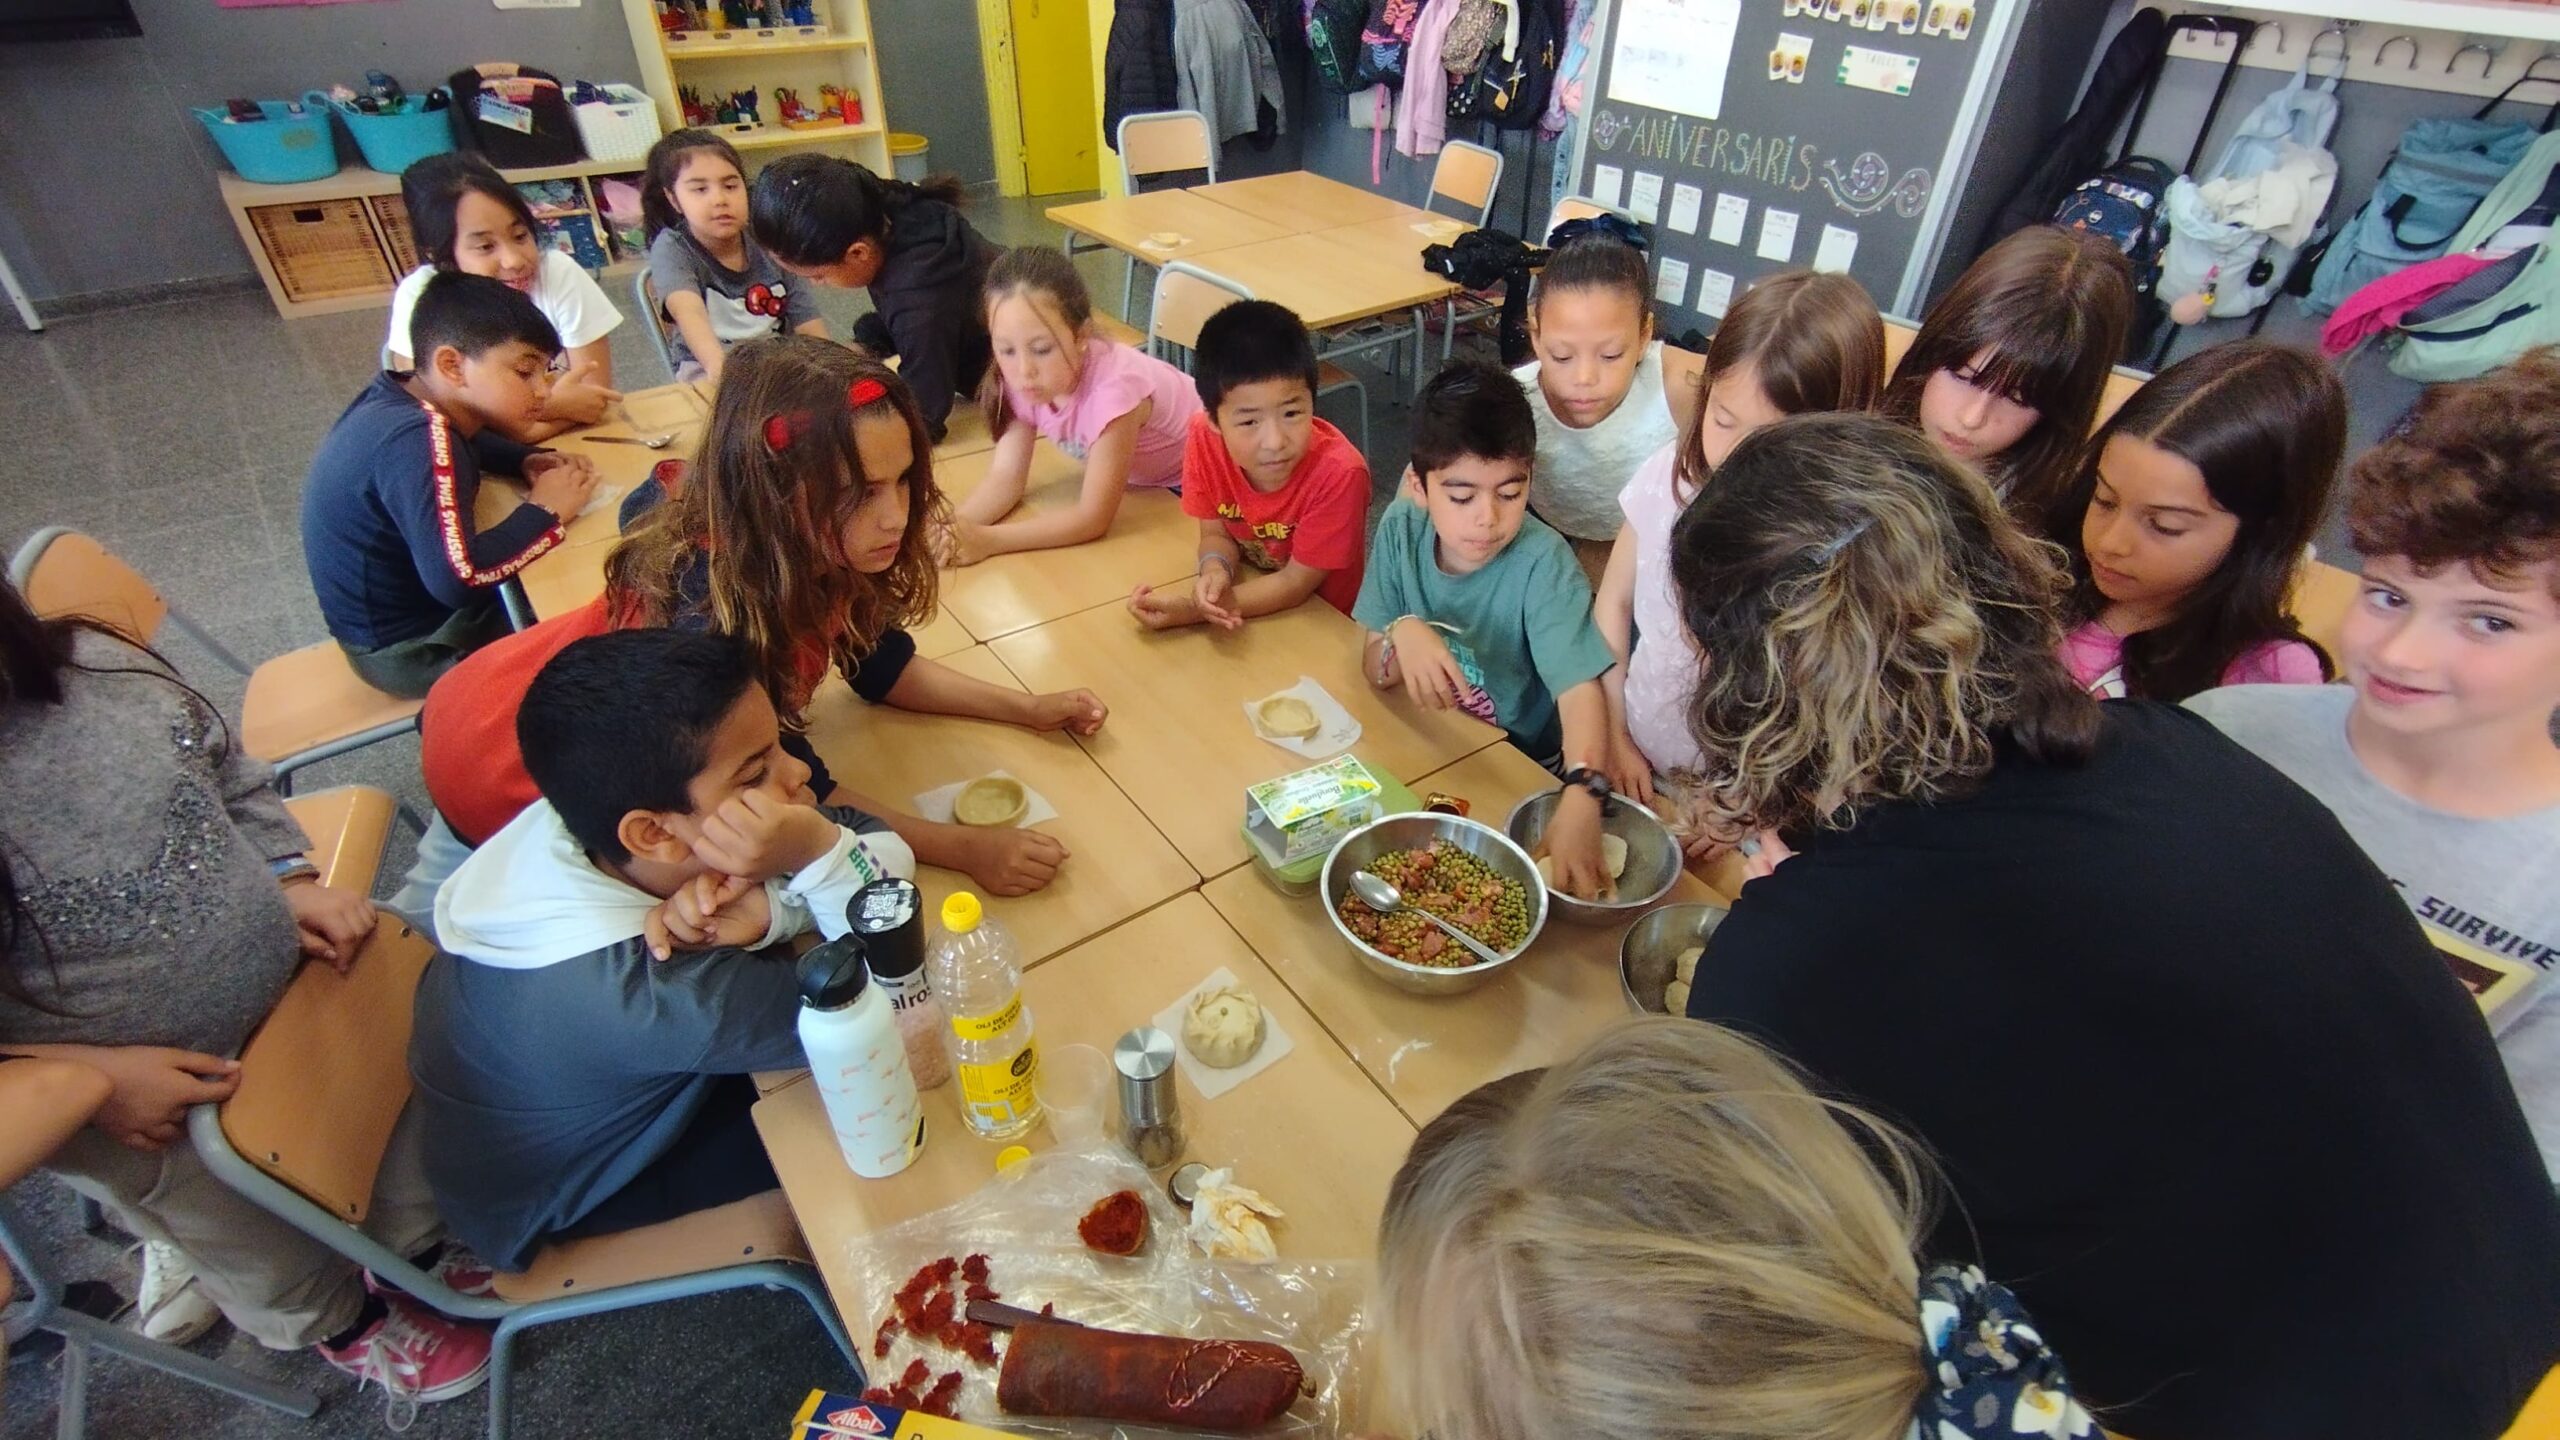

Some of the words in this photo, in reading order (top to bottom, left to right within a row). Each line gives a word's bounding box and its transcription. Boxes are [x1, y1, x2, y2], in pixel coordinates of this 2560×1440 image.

[437, 474, 454, 509] TIME
[2416, 895, 2560, 970] SURVIVE
[991, 1019, 1007, 1033] ALT
[835, 1411, 877, 1432] Albal
